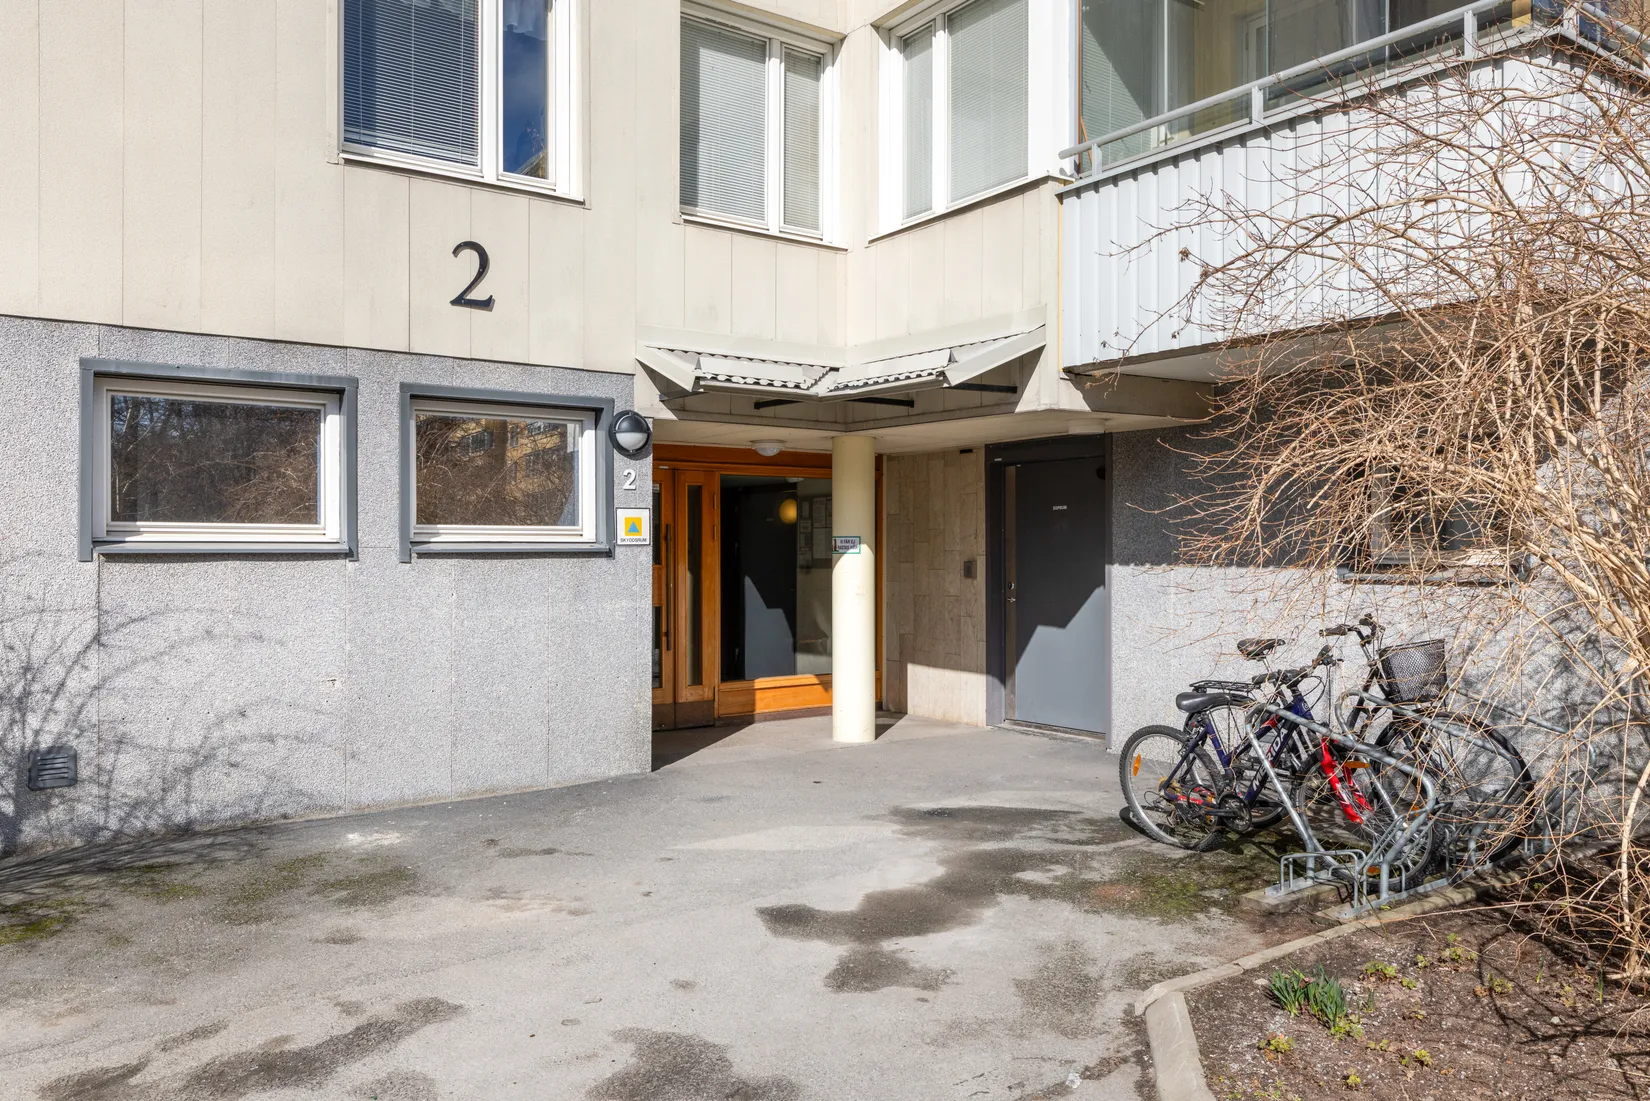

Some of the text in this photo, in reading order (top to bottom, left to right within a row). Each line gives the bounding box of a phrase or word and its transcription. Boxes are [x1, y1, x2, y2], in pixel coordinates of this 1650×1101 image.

[449, 240, 494, 309] 2
[623, 469, 636, 490] 2
[1252, 726, 1289, 791] MERIDA
